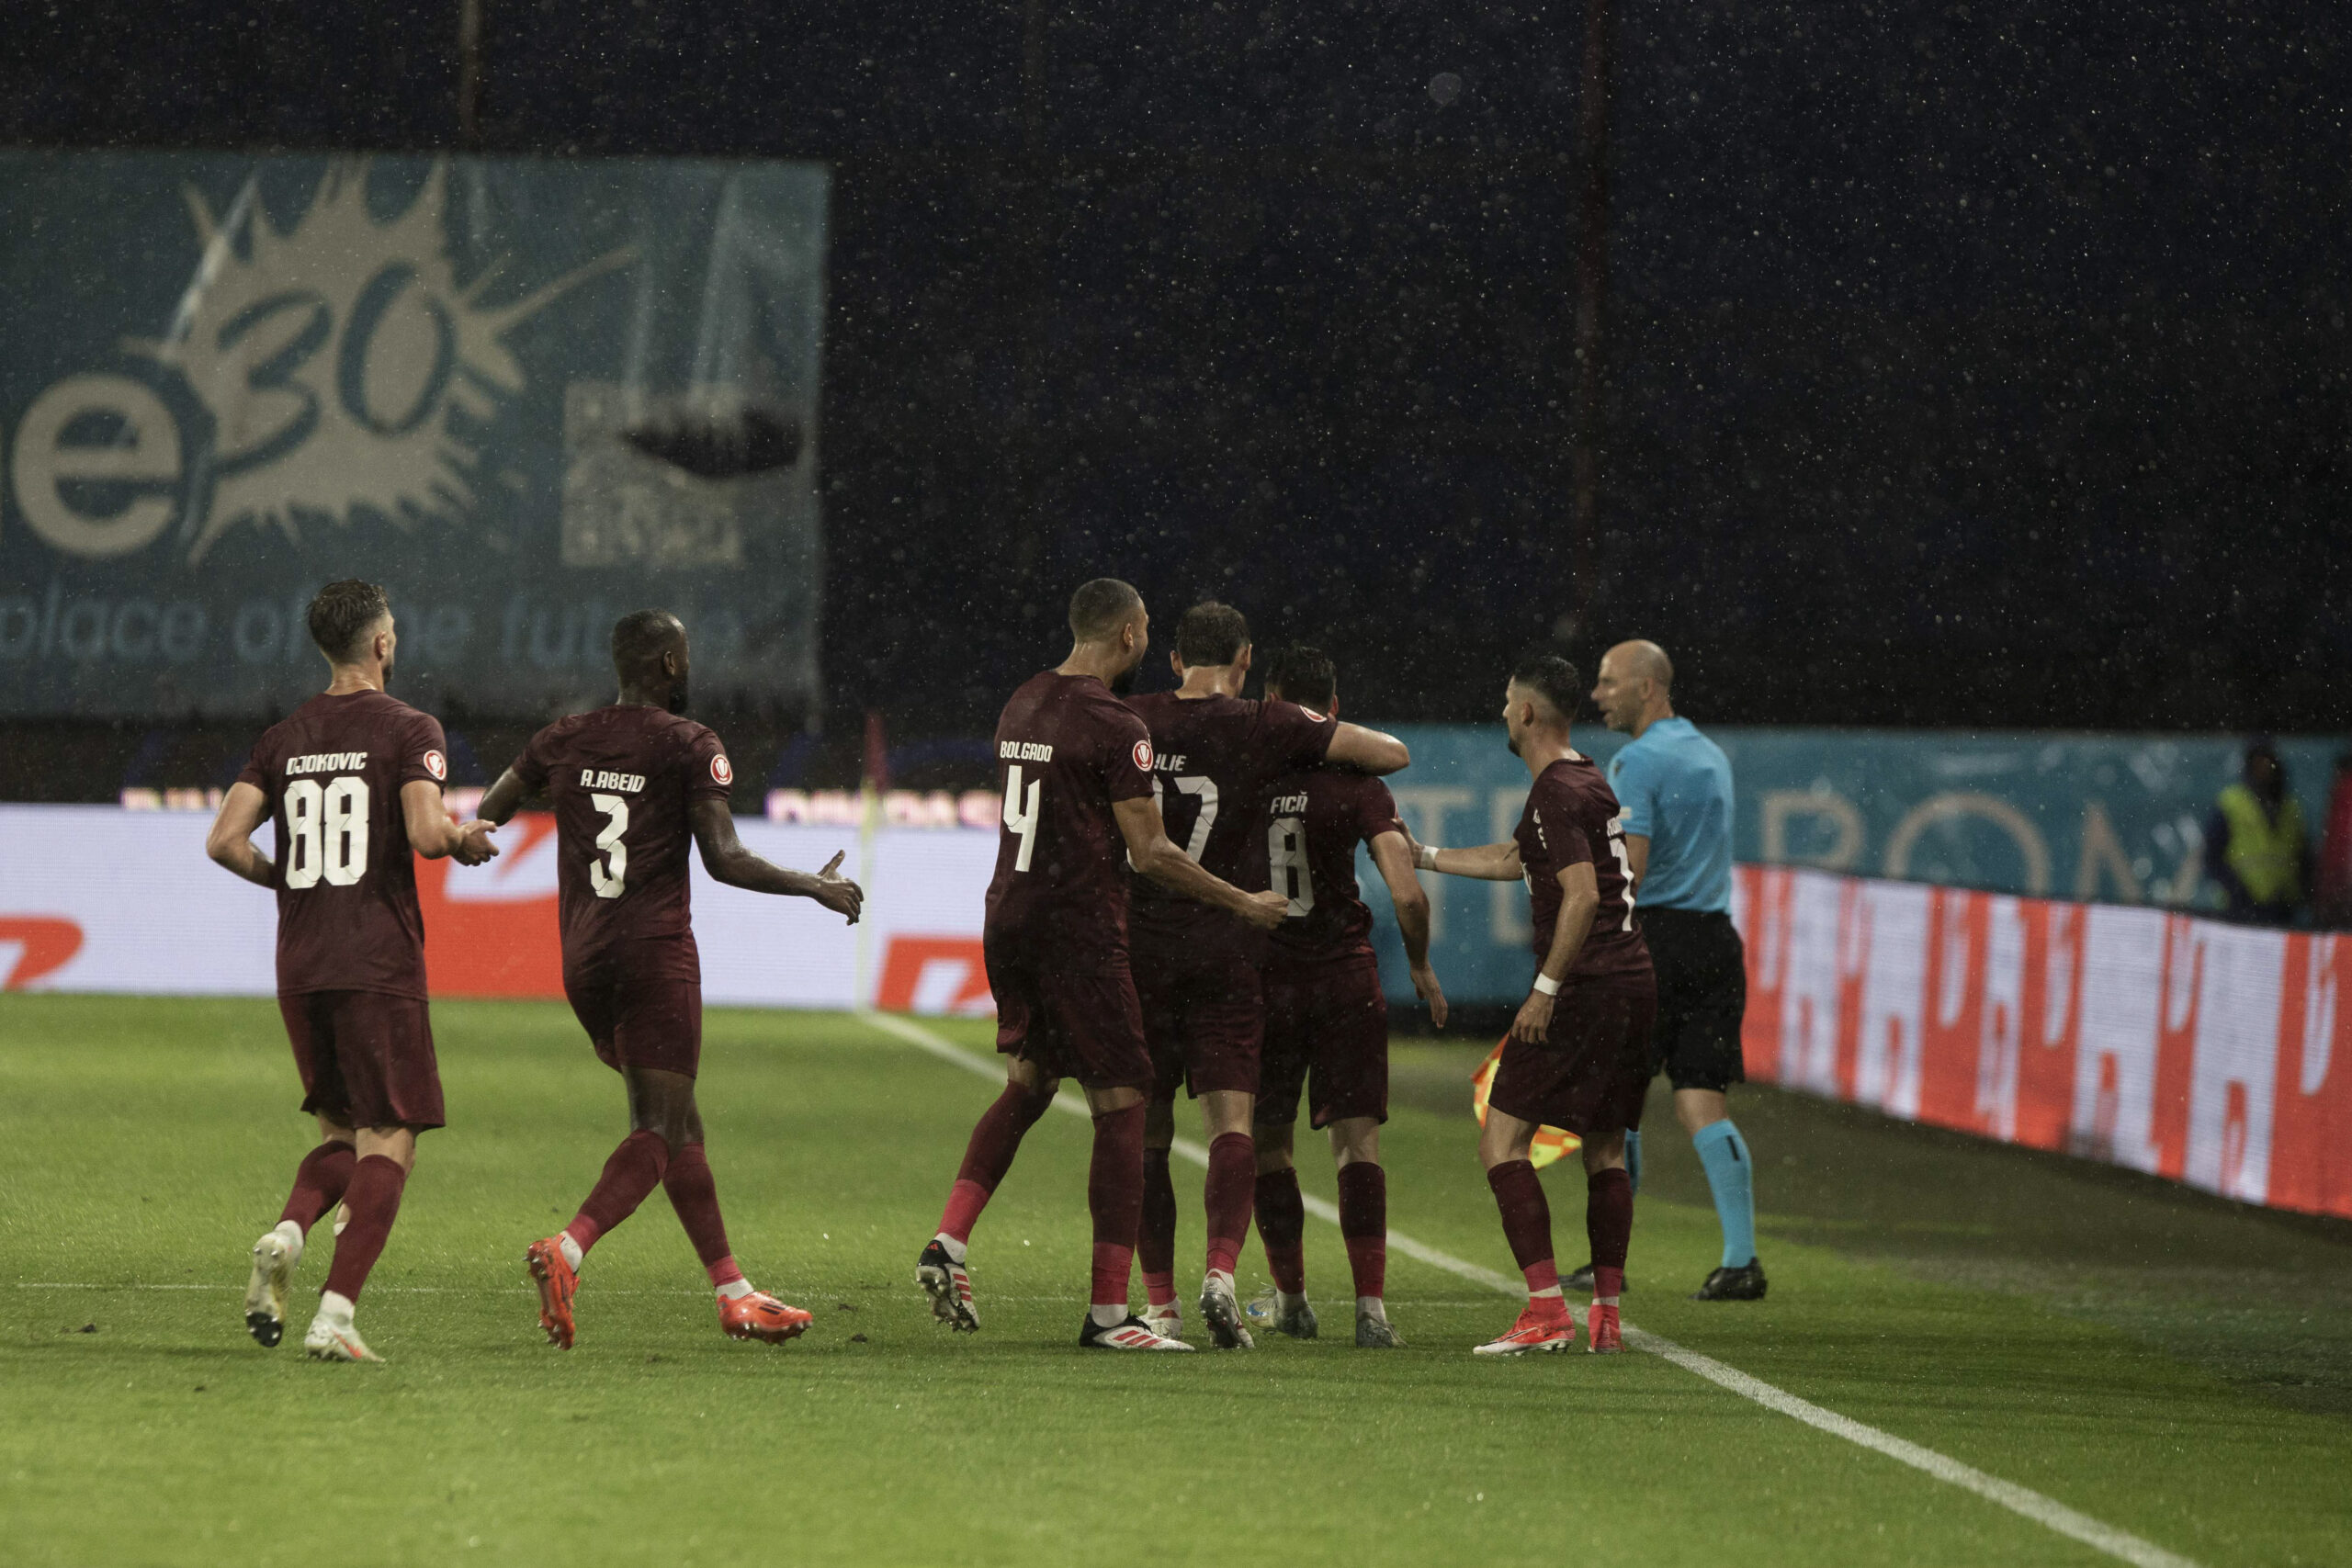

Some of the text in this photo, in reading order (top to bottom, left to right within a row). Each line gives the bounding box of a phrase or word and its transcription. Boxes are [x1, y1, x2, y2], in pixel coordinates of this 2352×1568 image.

[285, 751, 368, 776] DJOKOVIC
[580, 768, 647, 793] A.ABEID
[999, 740, 1053, 762] BOLGADO
[283, 776, 369, 890] 88
[589, 793, 629, 898] 3
[1002, 764, 1040, 873] 4
[1126, 773, 1219, 865] 7
[1267, 817, 1316, 918] 8
